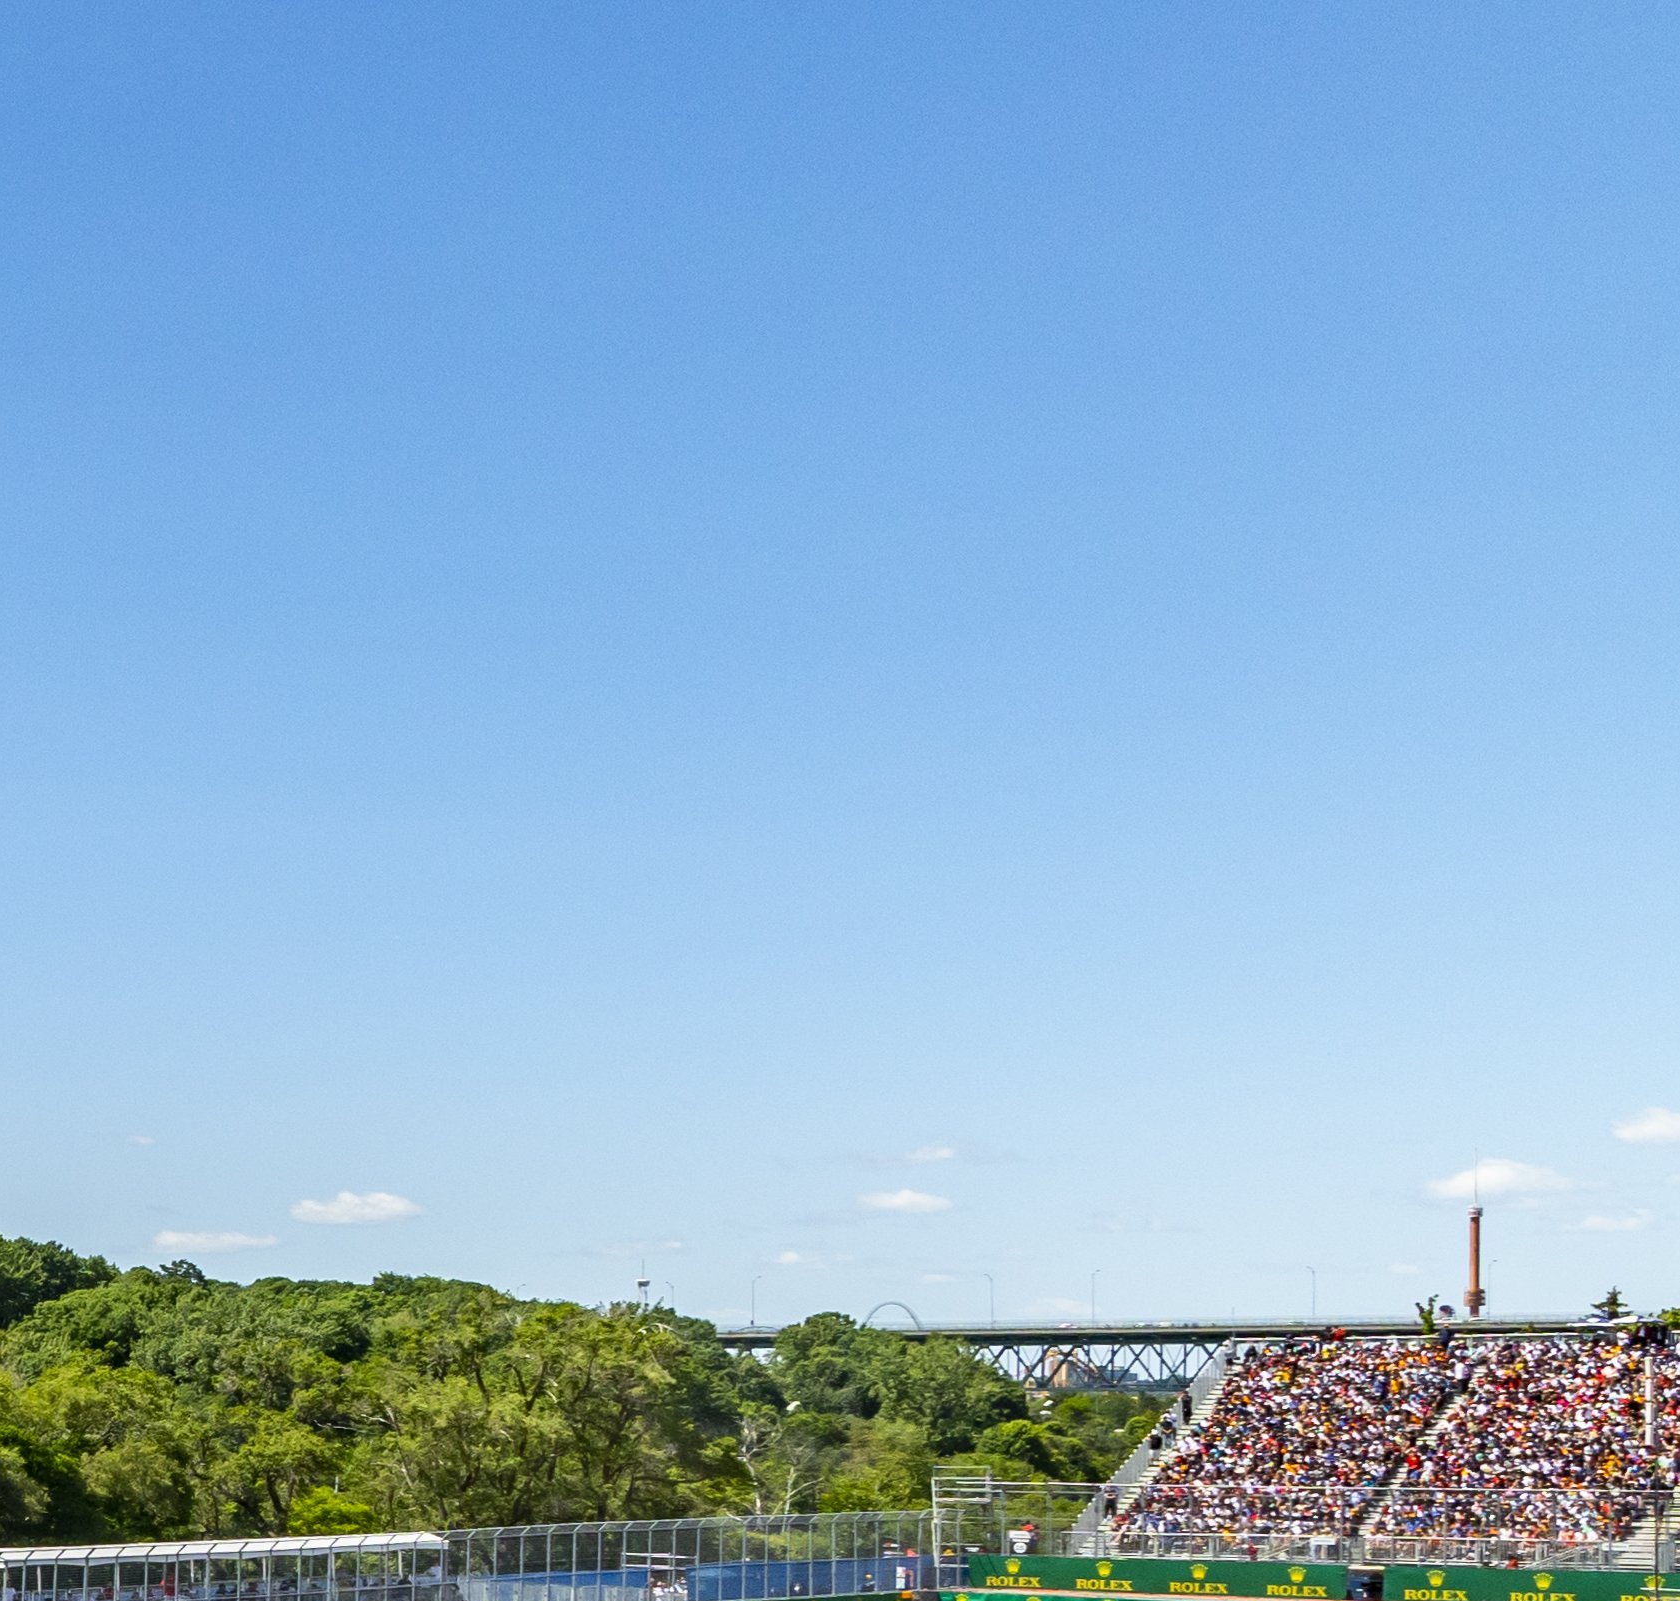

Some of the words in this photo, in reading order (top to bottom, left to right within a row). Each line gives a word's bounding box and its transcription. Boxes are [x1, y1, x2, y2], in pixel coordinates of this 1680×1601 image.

[987, 1577, 1041, 1587] ROLEX
[1076, 1579, 1133, 1591] ROLEX
[1170, 1582, 1227, 1594] ROLEX
[1267, 1585, 1326, 1597] ROLEX
[1405, 1590, 1467, 1601] ROLEX
